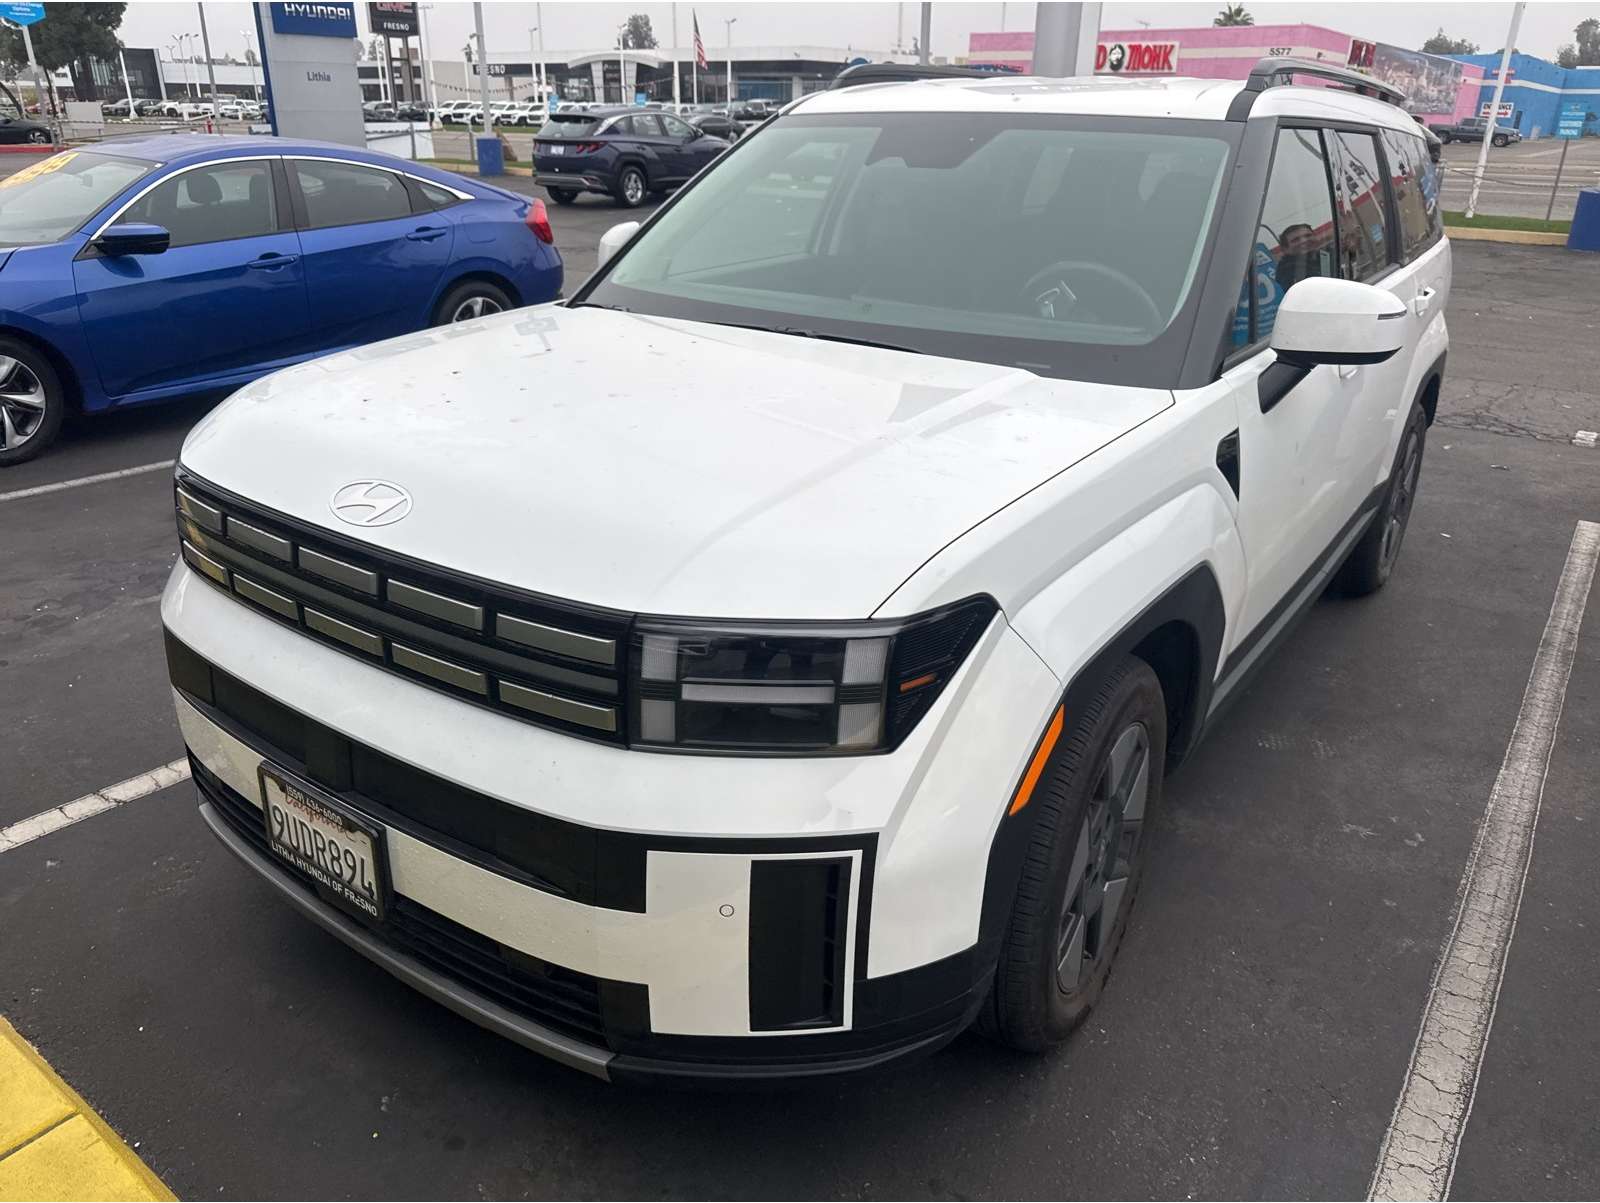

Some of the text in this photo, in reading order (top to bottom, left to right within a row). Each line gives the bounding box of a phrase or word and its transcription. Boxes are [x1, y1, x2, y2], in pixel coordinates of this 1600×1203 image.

[284, 3, 351, 20] HYUNDAI
[383, 22, 409, 31] FRESNO
[1125, 44, 1175, 71] MONK
[1269, 47, 1292, 56] 5577
[475, 64, 506, 74] FESNO
[307, 71, 332, 82] Lithia
[272, 804, 377, 899] 9UDR894
[271, 840, 378, 917] LITHIA HYUNDAI OF FRESNO
